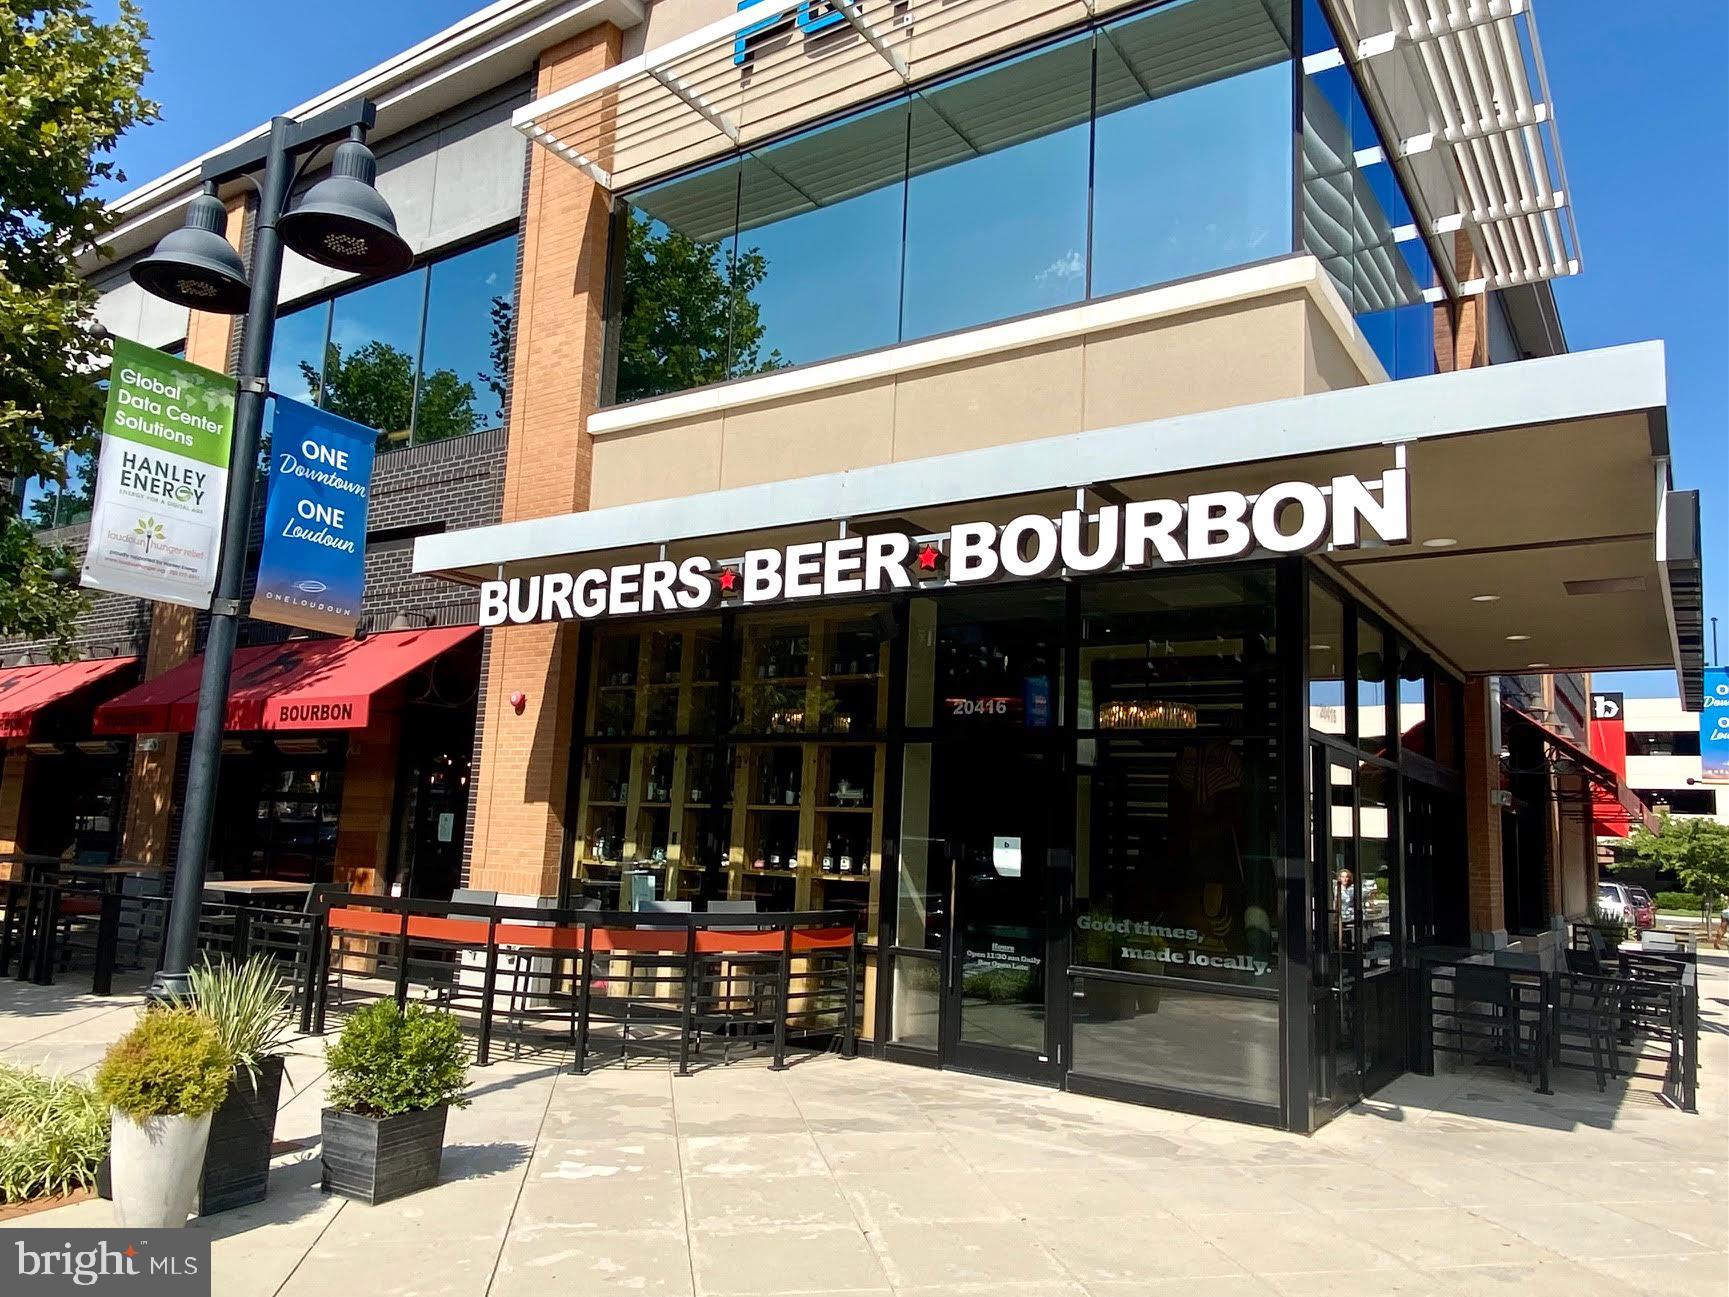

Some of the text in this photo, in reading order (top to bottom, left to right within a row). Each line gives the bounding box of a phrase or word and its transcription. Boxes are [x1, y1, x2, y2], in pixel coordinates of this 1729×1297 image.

[120, 368, 181, 400] Global
[118, 388, 224, 436] Data Center
[114, 409, 194, 447] Solutions
[122, 451, 206, 488] HANLEY
[301, 440, 349, 471] ONE
[120, 469, 204, 506] ENERGY
[279, 453, 366, 498] Downtown
[297, 499, 345, 529] ONE
[107, 530, 146, 546] loudoun
[151, 540, 182, 556] hunger
[282, 517, 355, 554] Loudoun
[478, 467, 1407, 626] BURGERS BEER BOURBON
[265, 591, 351, 616] ONELOUDOUN
[279, 703, 353, 723] BOURBON
[952, 698, 1007, 715] 20416
[1076, 915, 1204, 943] Good times,
[966, 949, 986, 958] Open
[1020, 956, 1041, 965] Daily
[991, 960, 1011, 969] Open
[1121, 945, 1272, 976] made locally.
